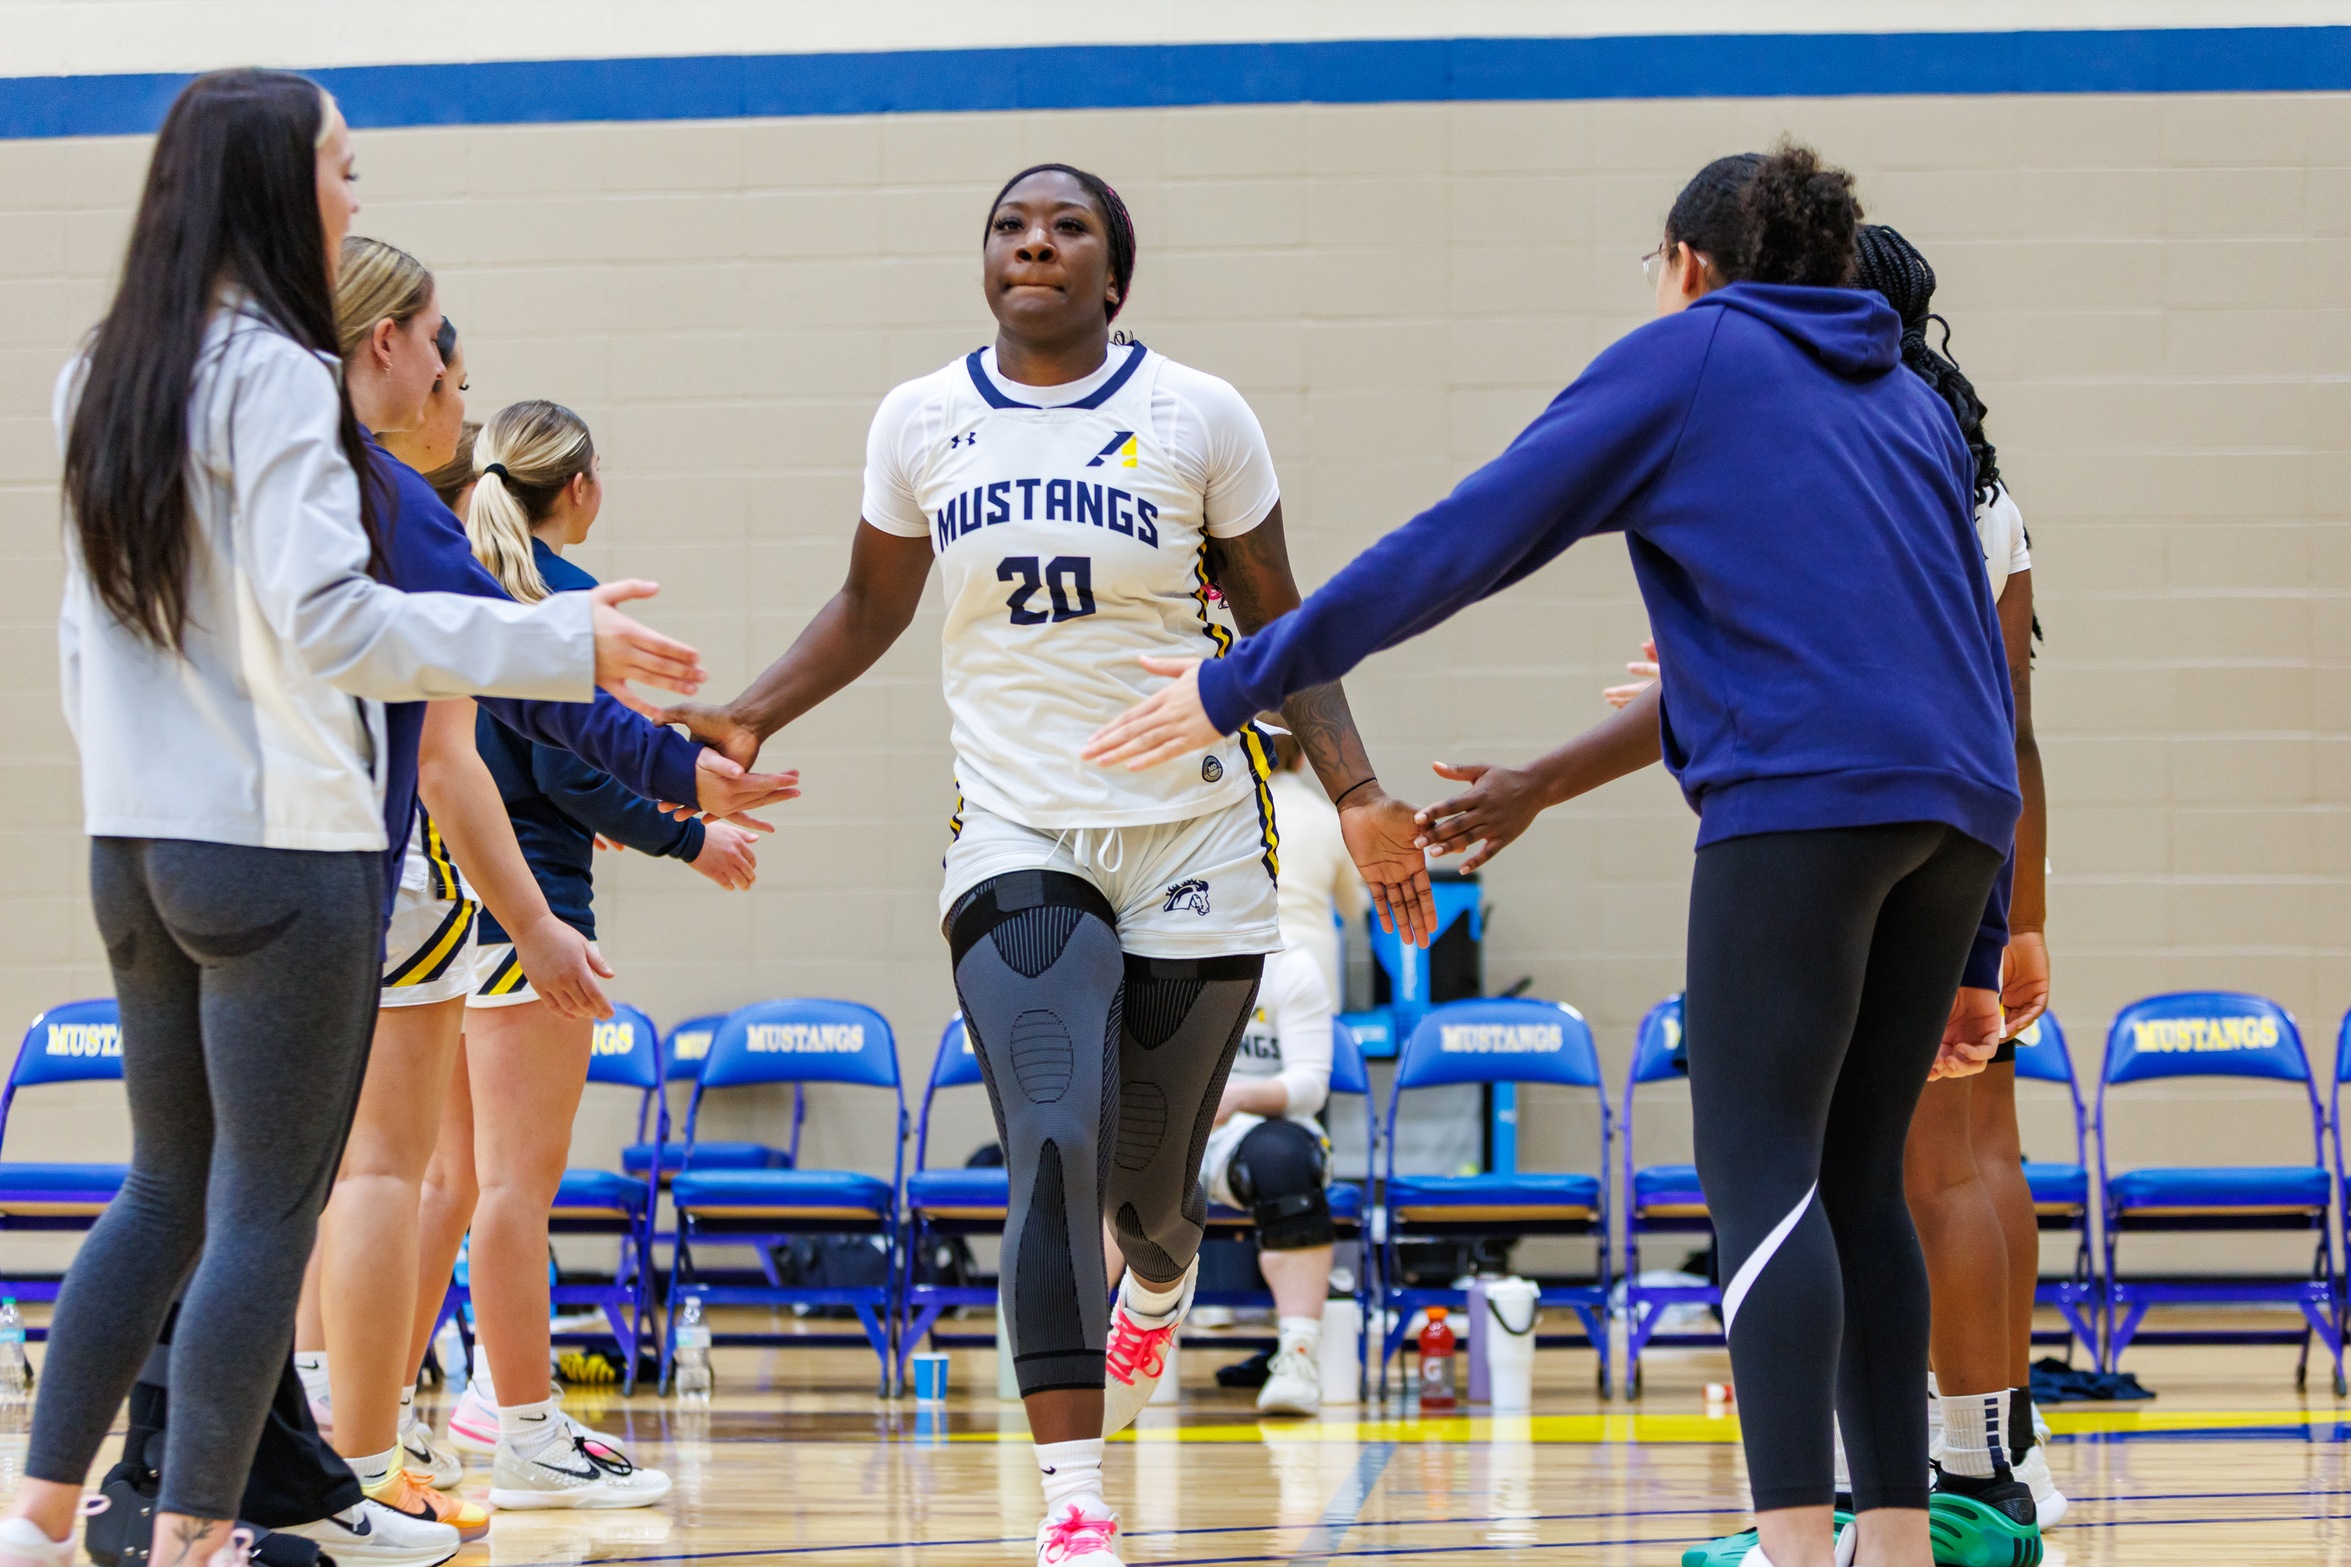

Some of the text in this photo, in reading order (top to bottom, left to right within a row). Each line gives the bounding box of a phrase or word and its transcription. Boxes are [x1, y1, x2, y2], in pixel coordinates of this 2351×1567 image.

[937, 478, 1159, 553] MUSTANGS
[996, 556, 1096, 625] 20
[746, 1024, 864, 1053] MUSTANGS
[1441, 1024, 1562, 1053] MUSTANGS
[2134, 1015, 2279, 1053] MUSTANGS
